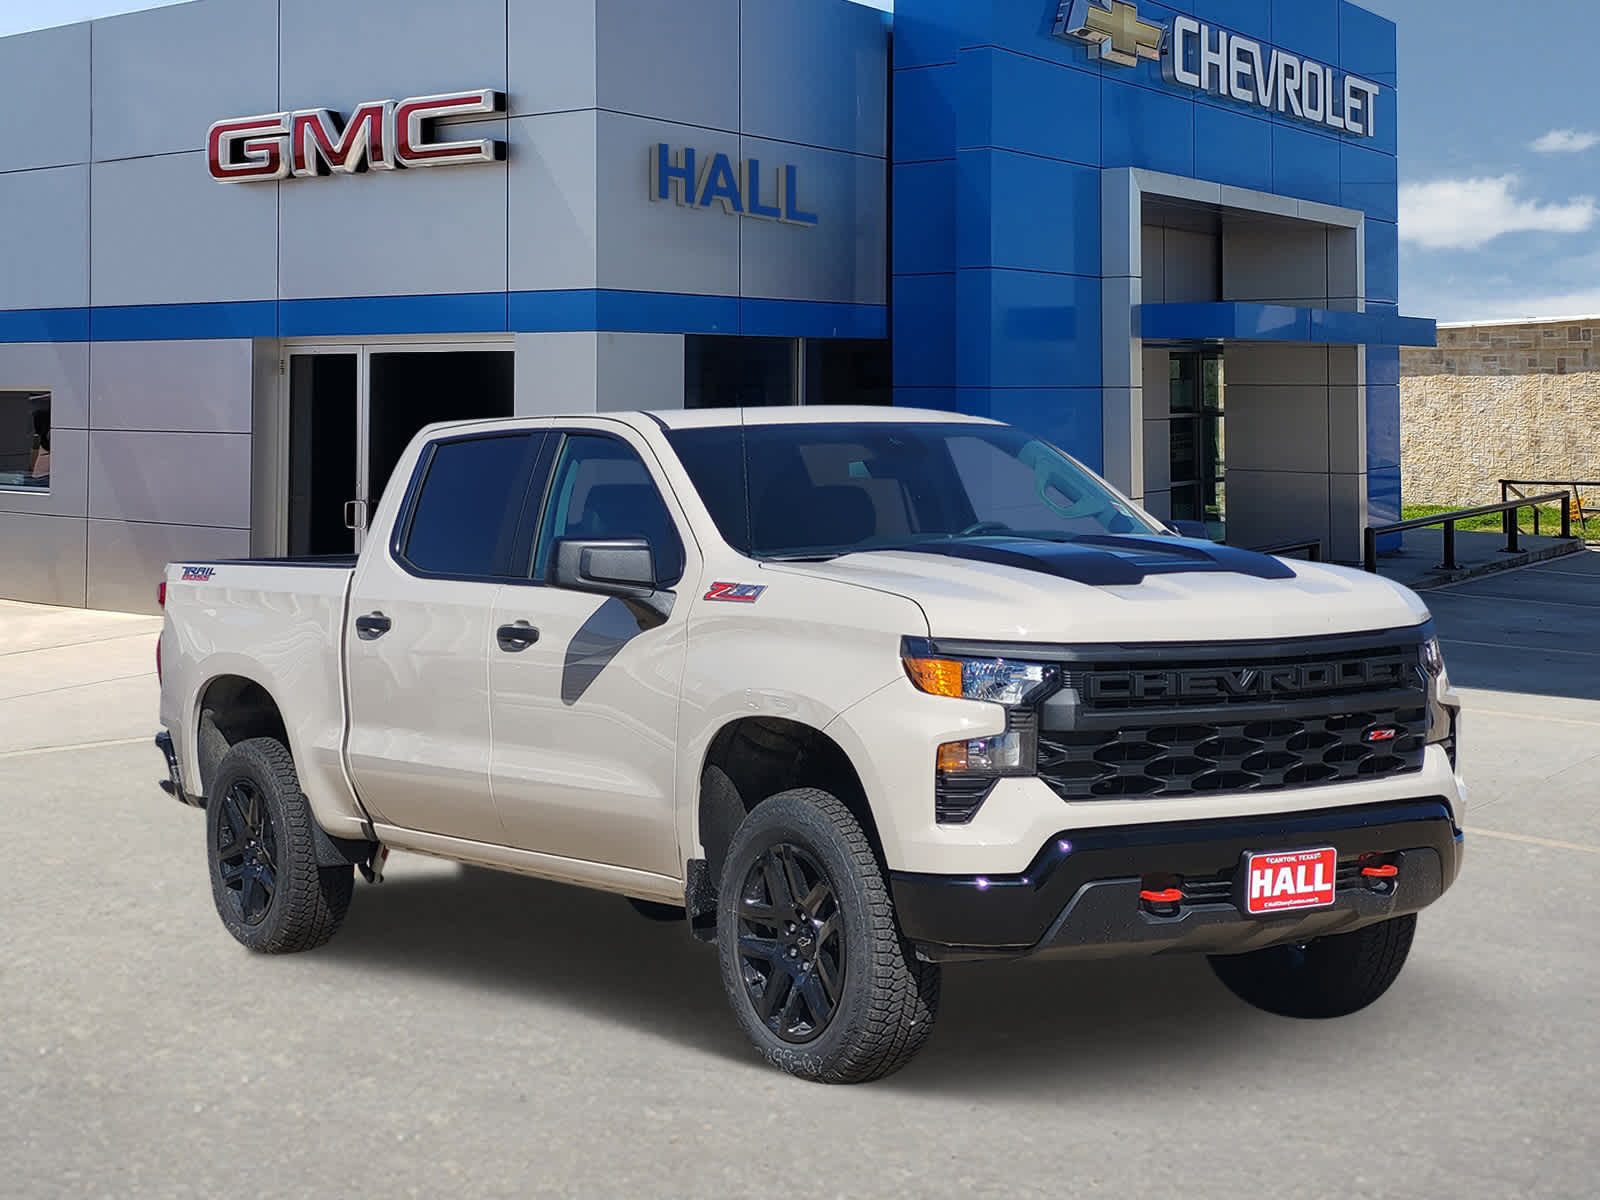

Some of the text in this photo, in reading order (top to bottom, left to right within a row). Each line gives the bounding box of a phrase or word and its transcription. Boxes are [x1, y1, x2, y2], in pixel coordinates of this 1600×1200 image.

[1173, 15, 1380, 137] CHEVROLET
[207, 88, 505, 184] GMC
[652, 142, 819, 226] HALL
[182, 566, 216, 576] TRAIL
[703, 582, 766, 603] Z71
[1251, 863, 1332, 899] HALL
